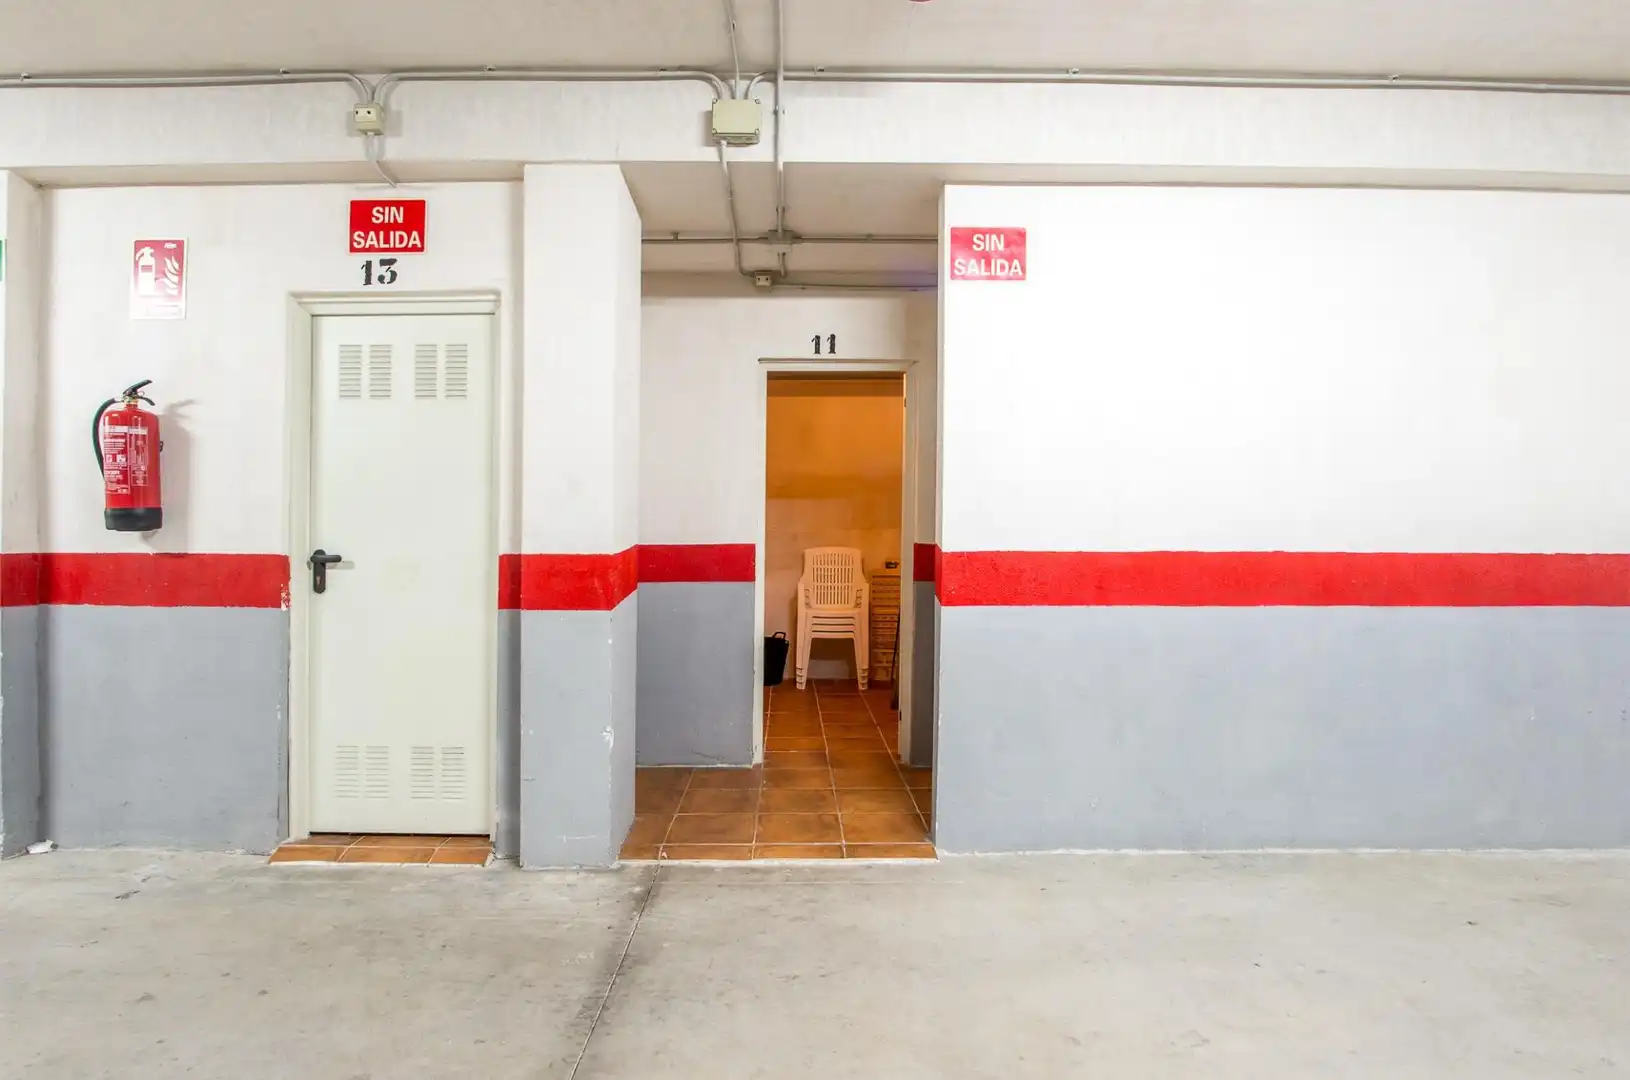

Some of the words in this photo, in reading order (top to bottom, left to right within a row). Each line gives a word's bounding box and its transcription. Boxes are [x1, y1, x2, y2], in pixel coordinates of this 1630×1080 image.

[372, 206, 404, 224] SIN
[353, 230, 422, 249] SALIDA
[972, 233, 1005, 252] SIN
[361, 258, 398, 286] 13
[954, 258, 1023, 276] SALIDA
[811, 333, 837, 355] 11
